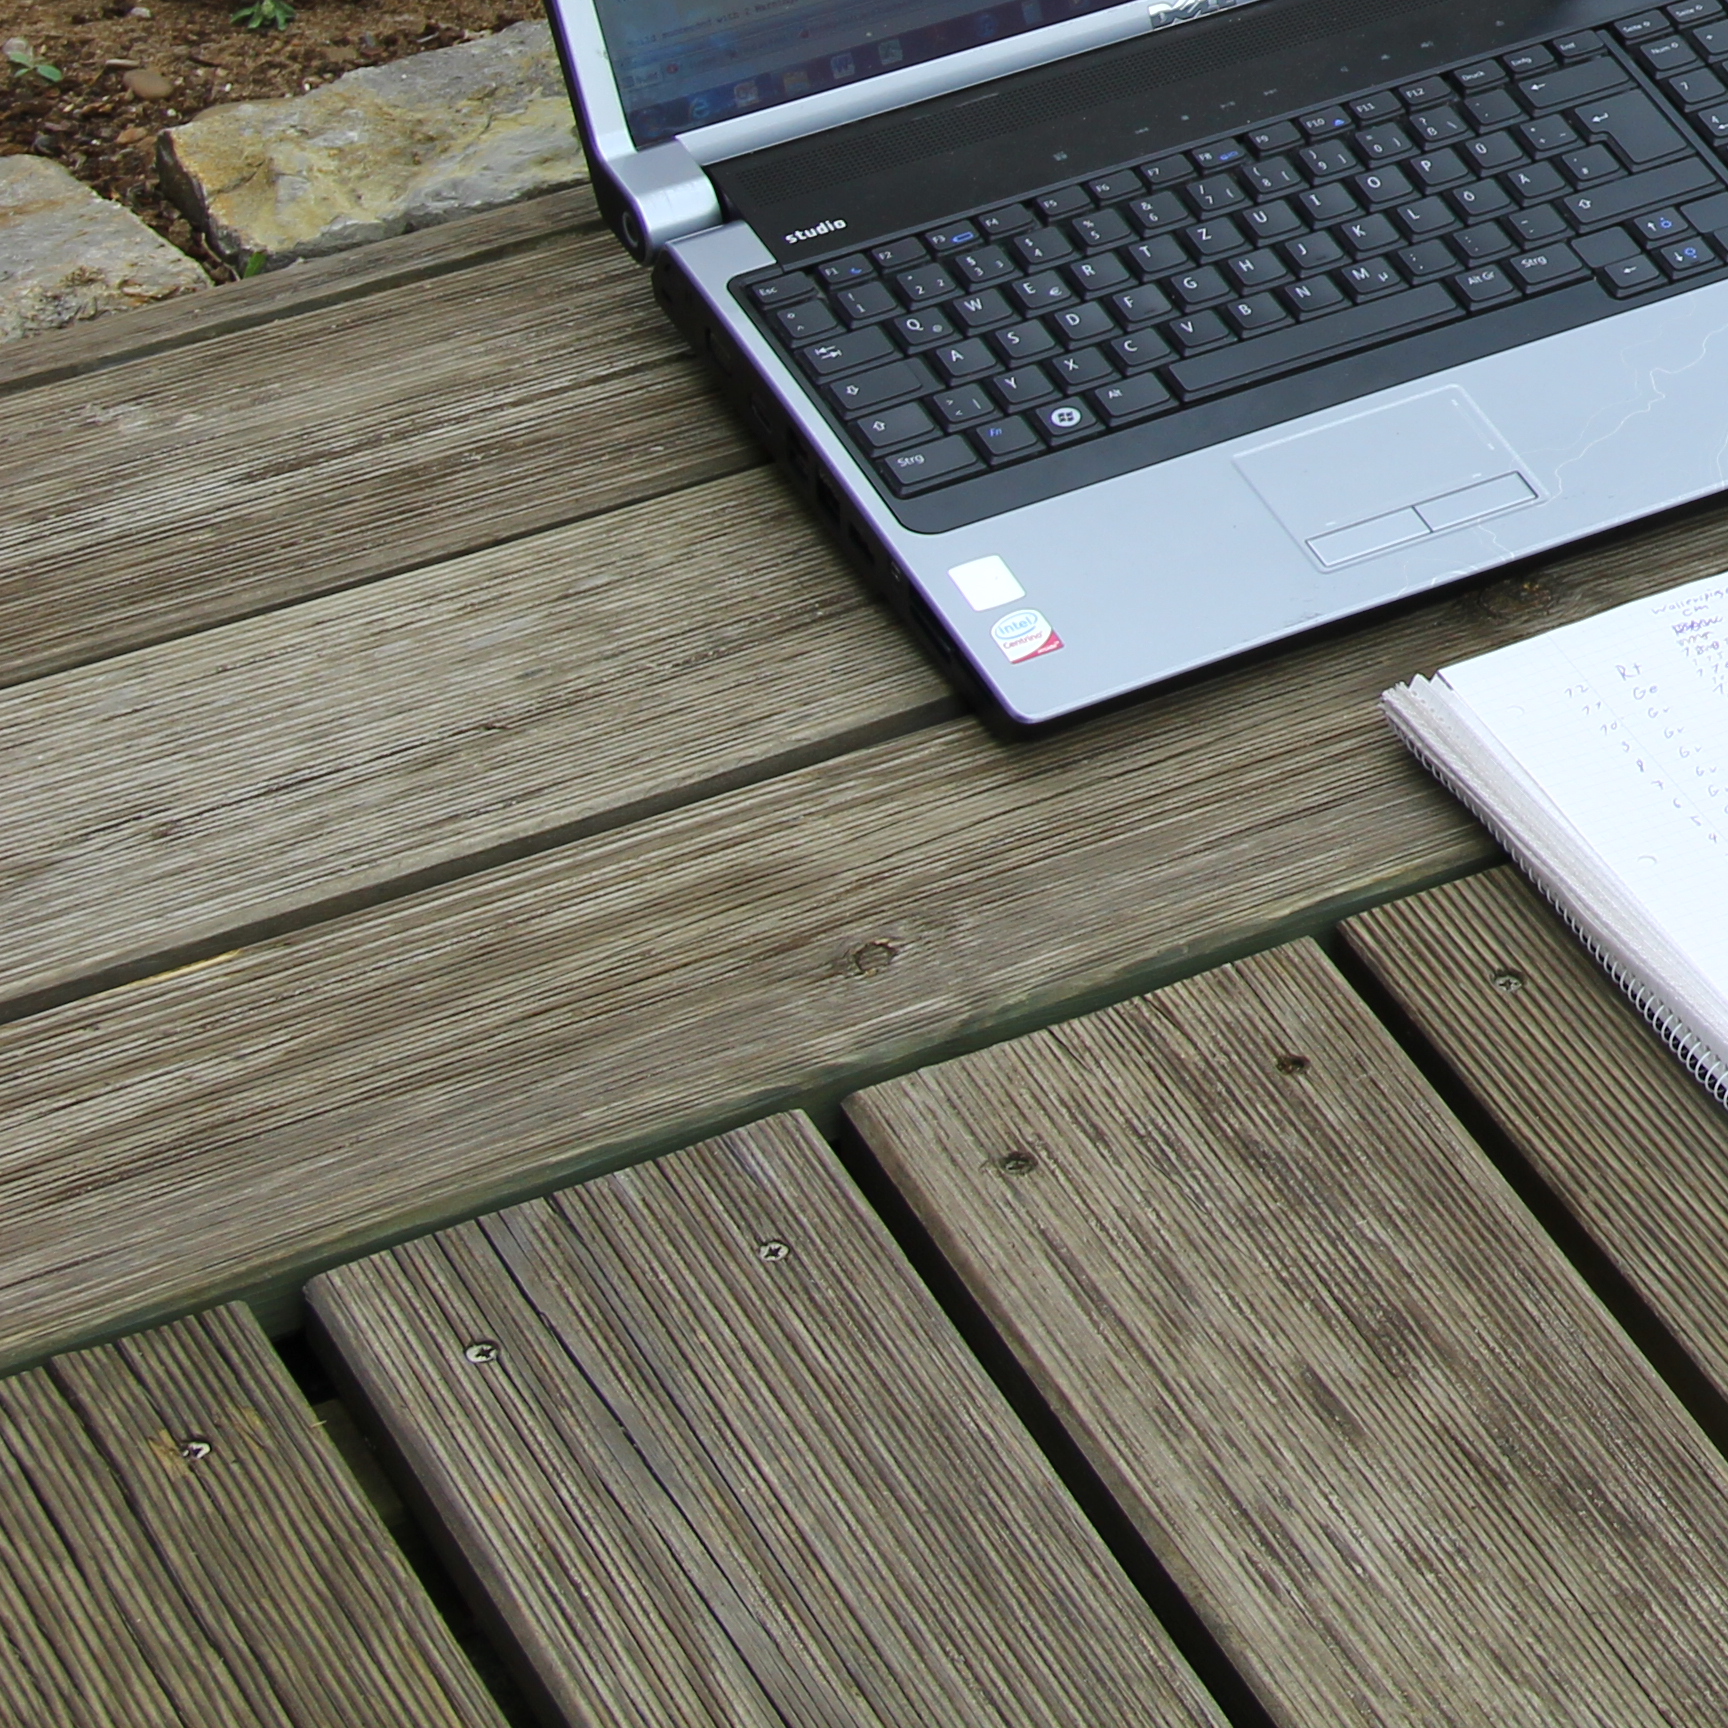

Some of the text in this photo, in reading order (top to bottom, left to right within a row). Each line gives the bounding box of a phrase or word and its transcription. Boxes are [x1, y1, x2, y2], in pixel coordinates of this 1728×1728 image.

[1405, 88, 1425, 98] F12
[1356, 102, 1375, 113] F11
[1306, 118, 1325, 128] F10
[1255, 135, 1269, 144] F9
[1198, 152, 1213, 161] F8
[1317, 161, 1327, 170] 9
[1420, 160, 1431, 172] P
[1147, 167, 1159, 177] F7
[1095, 183, 1110, 192] F6
[1261, 178, 1272, 187] 8
[1367, 176, 1381, 188] O
[1043, 199, 1058, 208] F5
[1205, 195, 1213, 204] 7
[1148, 213, 1159, 222] 6
[1253, 210, 1267, 223] U
[1407, 209, 1420, 220] L
[985, 218, 999, 227] F4
[785, 219, 846, 244] studio
[1090, 230, 1100, 240] 5
[1197, 228, 1212, 241] Z
[1351, 224, 1366, 237] K
[931, 235, 946, 244] F3
[1034, 248, 1043, 257] 4
[1138, 245, 1151, 258] T
[1298, 243, 1307, 255] J
[878, 251, 892, 260] F2
[1238, 259, 1254, 272] H
[1521, 256, 1547, 268] Strg
[824, 267, 839, 276] F1
[974, 267, 984, 277] 3
[1081, 264, 1095, 276] R
[1351, 267, 1370, 280] M
[1183, 277, 1198, 289] G
[1467, 271, 1494, 285] Alt Gr
[758, 287, 777, 296] Esc
[915, 285, 924, 295] 2
[1022, 282, 1036, 294] E
[1295, 285, 1311, 298] N
[964, 298, 982, 312] W
[1123, 296, 1133, 308] F
[856, 304, 866, 313] 1
[1238, 304, 1252, 316] B
[906, 318, 924, 331] Q
[1065, 313, 1080, 326] D
[1180, 321, 1193, 333] V
[1007, 331, 1020, 344] S
[1123, 340, 1138, 352] C
[951, 349, 964, 362] A
[1063, 358, 1079, 371] X
[1004, 376, 1017, 389] Y
[1108, 389, 1122, 399] Alt
[989, 428, 1002, 437] Fn
[897, 454, 925, 467] Strg
[1003, 633, 1042, 649] Centrino
